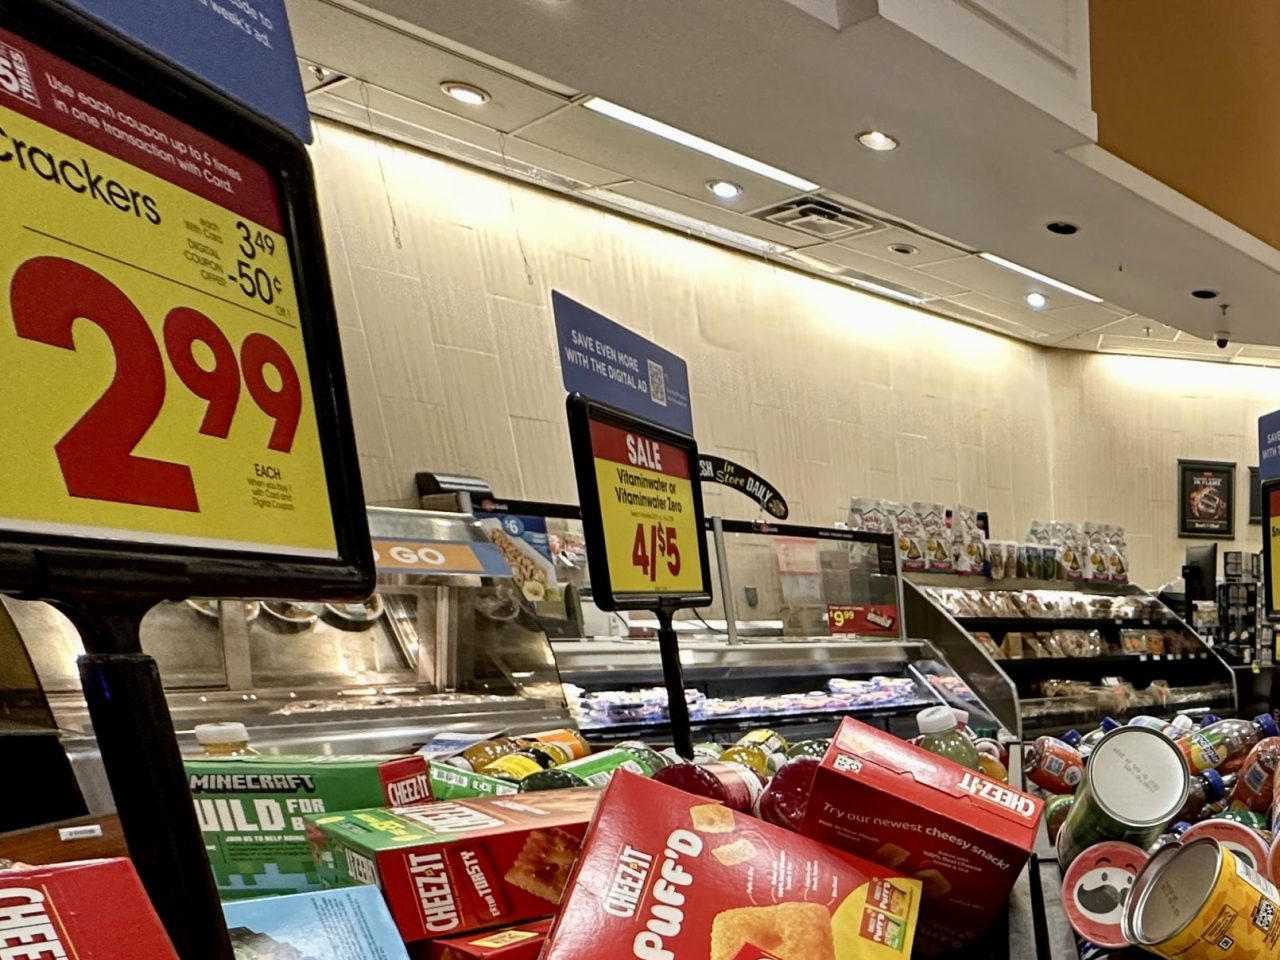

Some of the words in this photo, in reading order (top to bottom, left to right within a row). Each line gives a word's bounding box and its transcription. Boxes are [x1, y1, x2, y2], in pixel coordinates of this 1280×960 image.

[44, 71, 75, 98] Use
[78, 90, 116, 119] each
[116, 105, 169, 144] coupon
[170, 137, 188, 155] up
[189, 142, 202, 161] to
[203, 149, 213, 166] 5
[213, 154, 243, 182] times
[73, 104, 100, 128] one
[102, 116, 177, 164] transaction
[176, 154, 203, 181] with
[571, 329, 595, 352] SAVE
[595, 340, 617, 362] EVEN
[617, 351, 640, 373] MORE
[564, 346, 590, 369] WITH
[590, 356, 607, 377] THE
[607, 365, 637, 389] DIGITAL
[638, 378, 648, 393] AD
[1267, 429, 1280, 445] SAVE
[625, 433, 662, 472] SALE
[254, 463, 282, 480] EACH
[617, 467, 668, 494] Vitaminwater
[715, 470, 745, 487] Store
[615, 486, 666, 512] Vitaminwater
[667, 496, 682, 514] Zero
[746, 477, 773, 503] DAILY
[388, 545, 446, 566] GO
[190, 774, 315, 792] MINECRAFT
[286, 798, 325, 813] FOR
[822, 801, 845, 819] Try
[846, 812, 870, 824] our
[873, 816, 924, 834] newest
[925, 826, 971, 850] cheesy
[970, 843, 1011, 871] snack!
